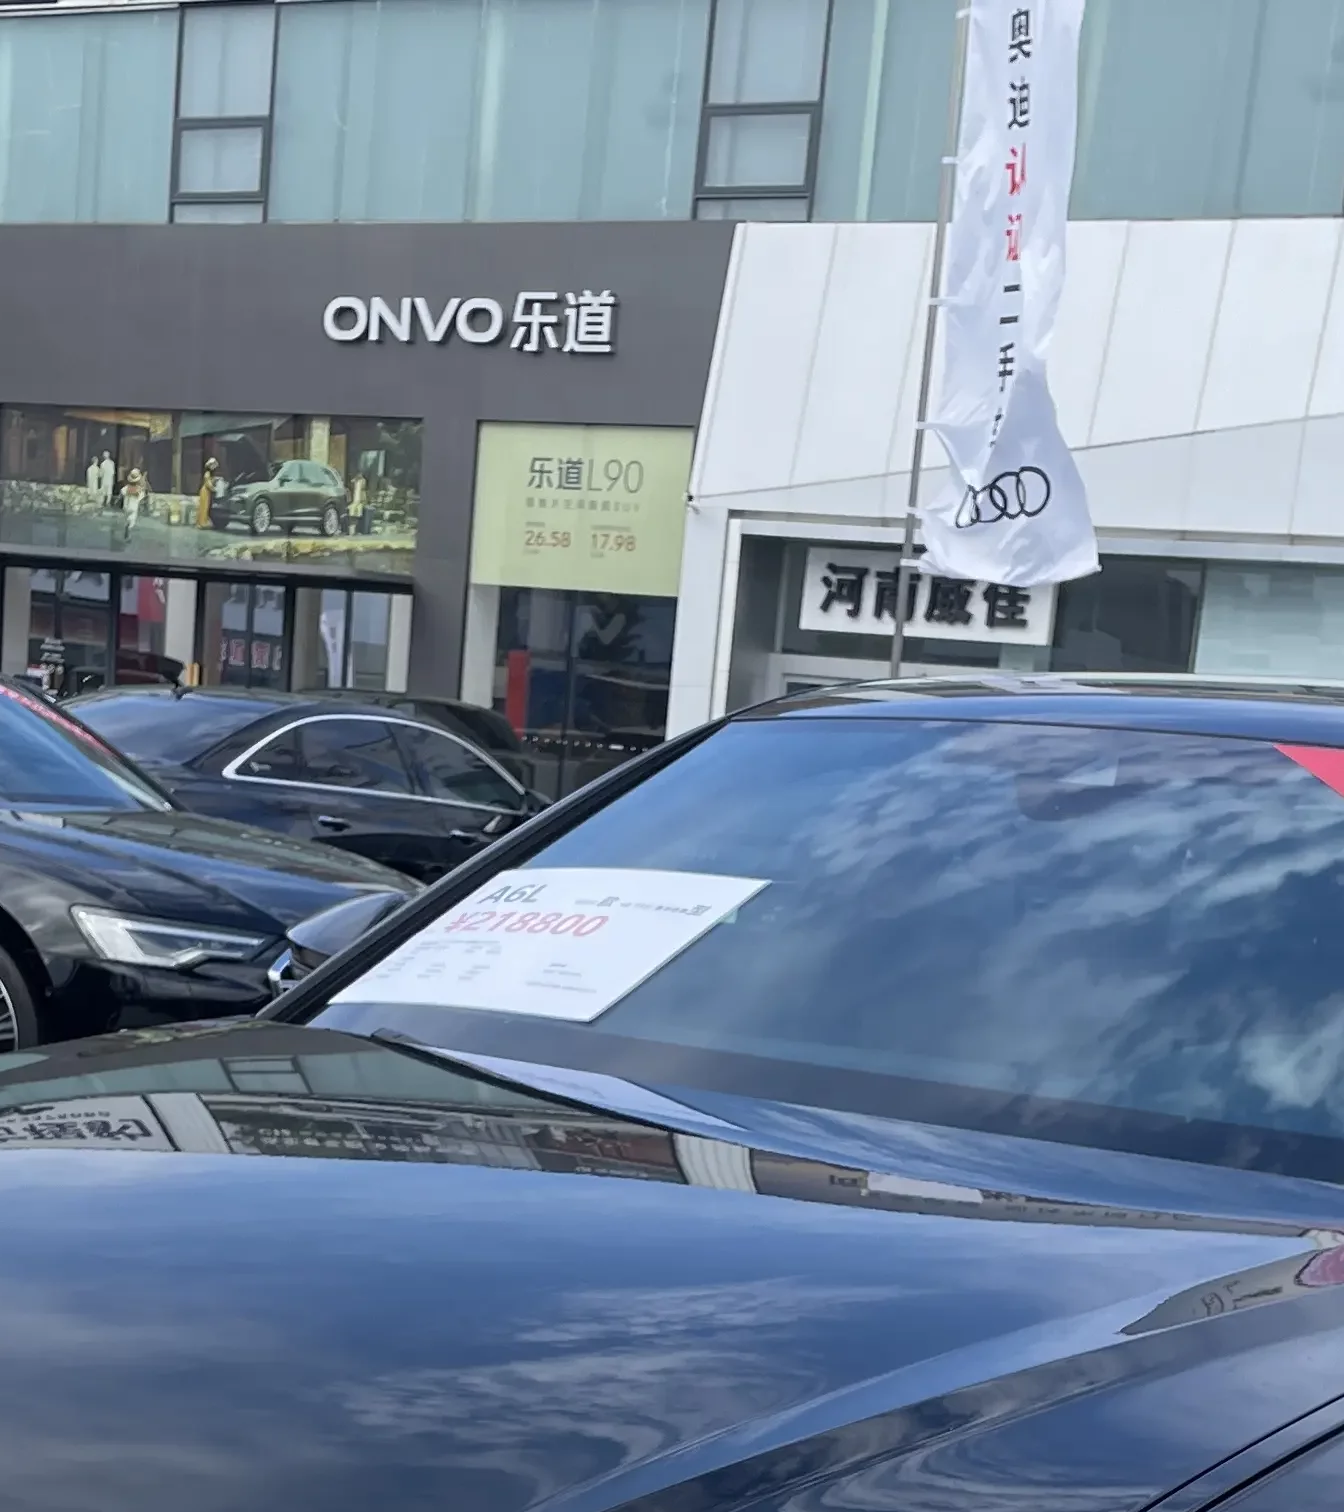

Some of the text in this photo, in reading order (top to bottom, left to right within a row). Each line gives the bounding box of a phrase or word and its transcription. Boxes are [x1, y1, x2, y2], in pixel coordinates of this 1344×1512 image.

[527, 457, 644, 494] 乐道L90
[819, 562, 1031, 628] 河南威佳
[477, 884, 547, 904] A6L
